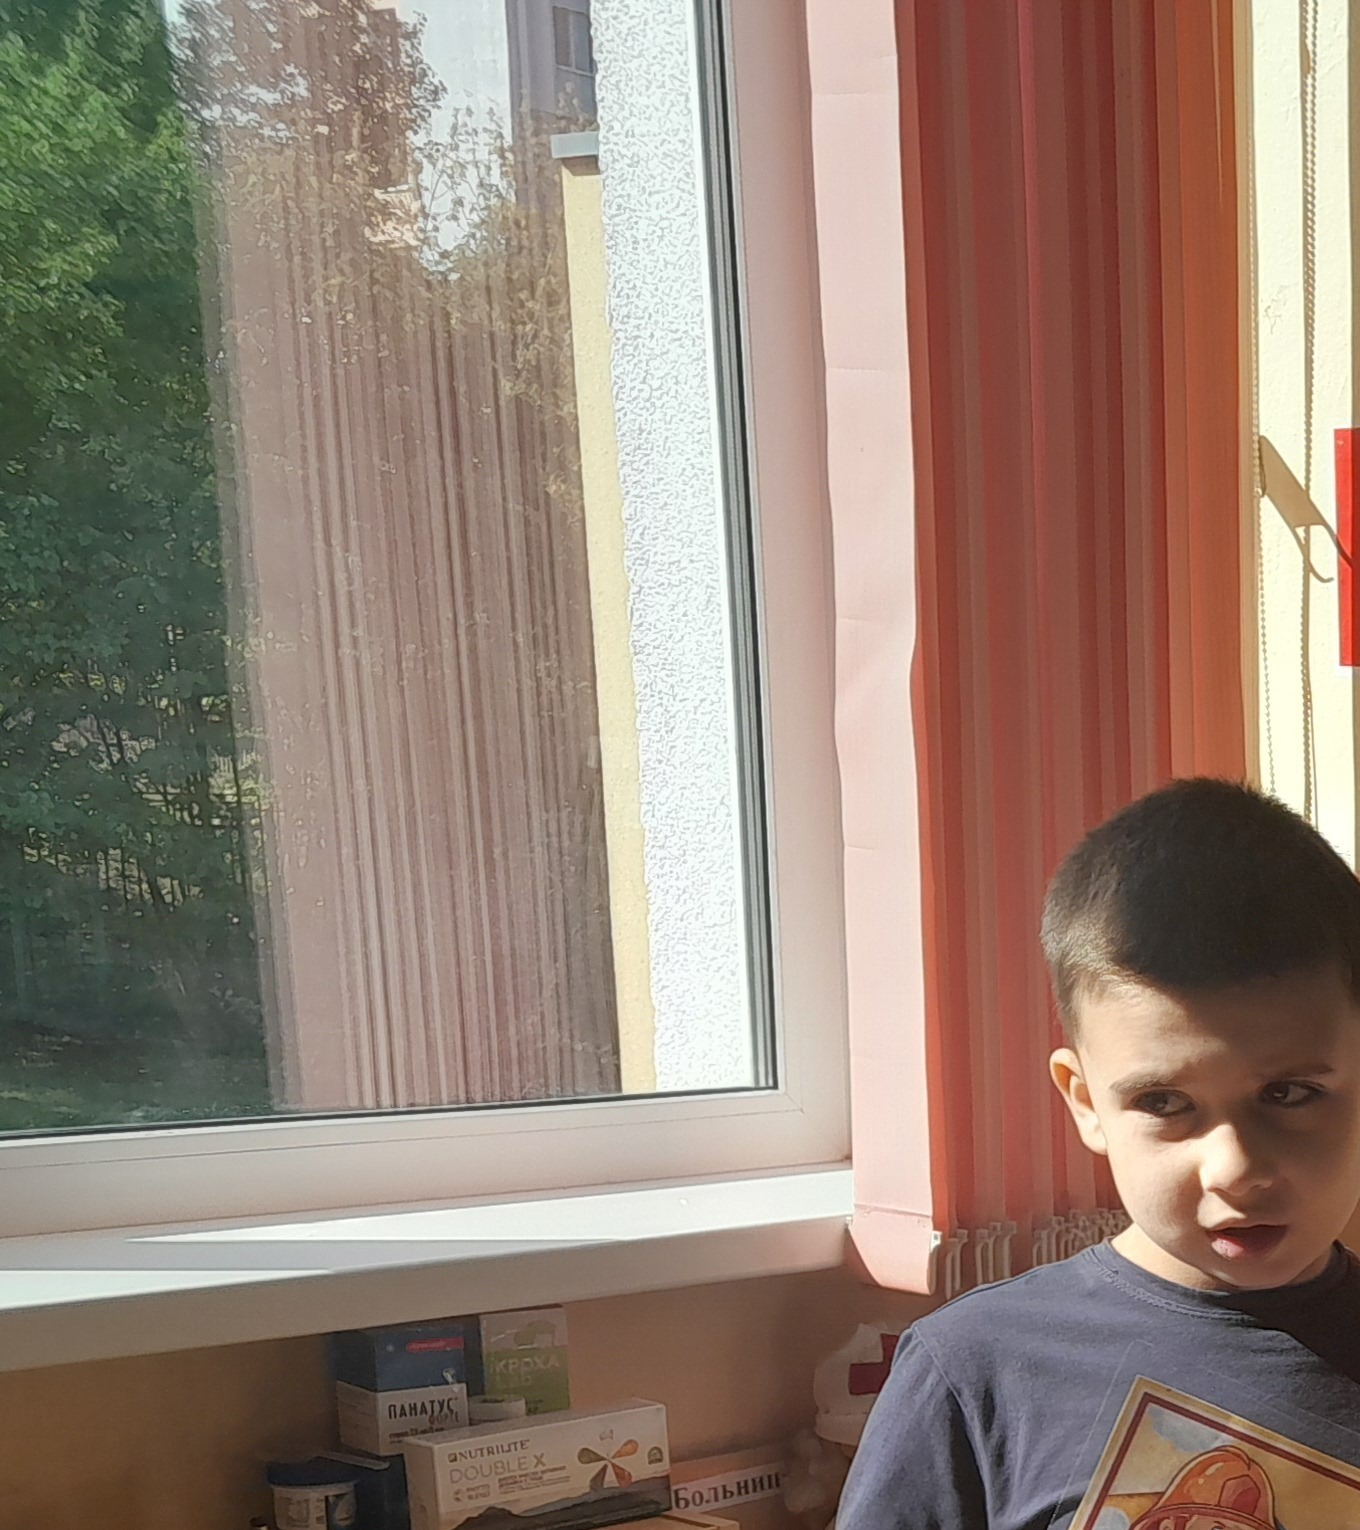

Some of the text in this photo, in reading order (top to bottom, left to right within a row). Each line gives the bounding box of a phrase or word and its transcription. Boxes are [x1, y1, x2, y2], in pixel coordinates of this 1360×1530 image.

[387, 1397, 455, 1420] ПАНАТУС
[459, 1439, 530, 1461] NUTRILITE
[449, 1457, 528, 1484] DOUBLE
[533, 1453, 547, 1469] X
